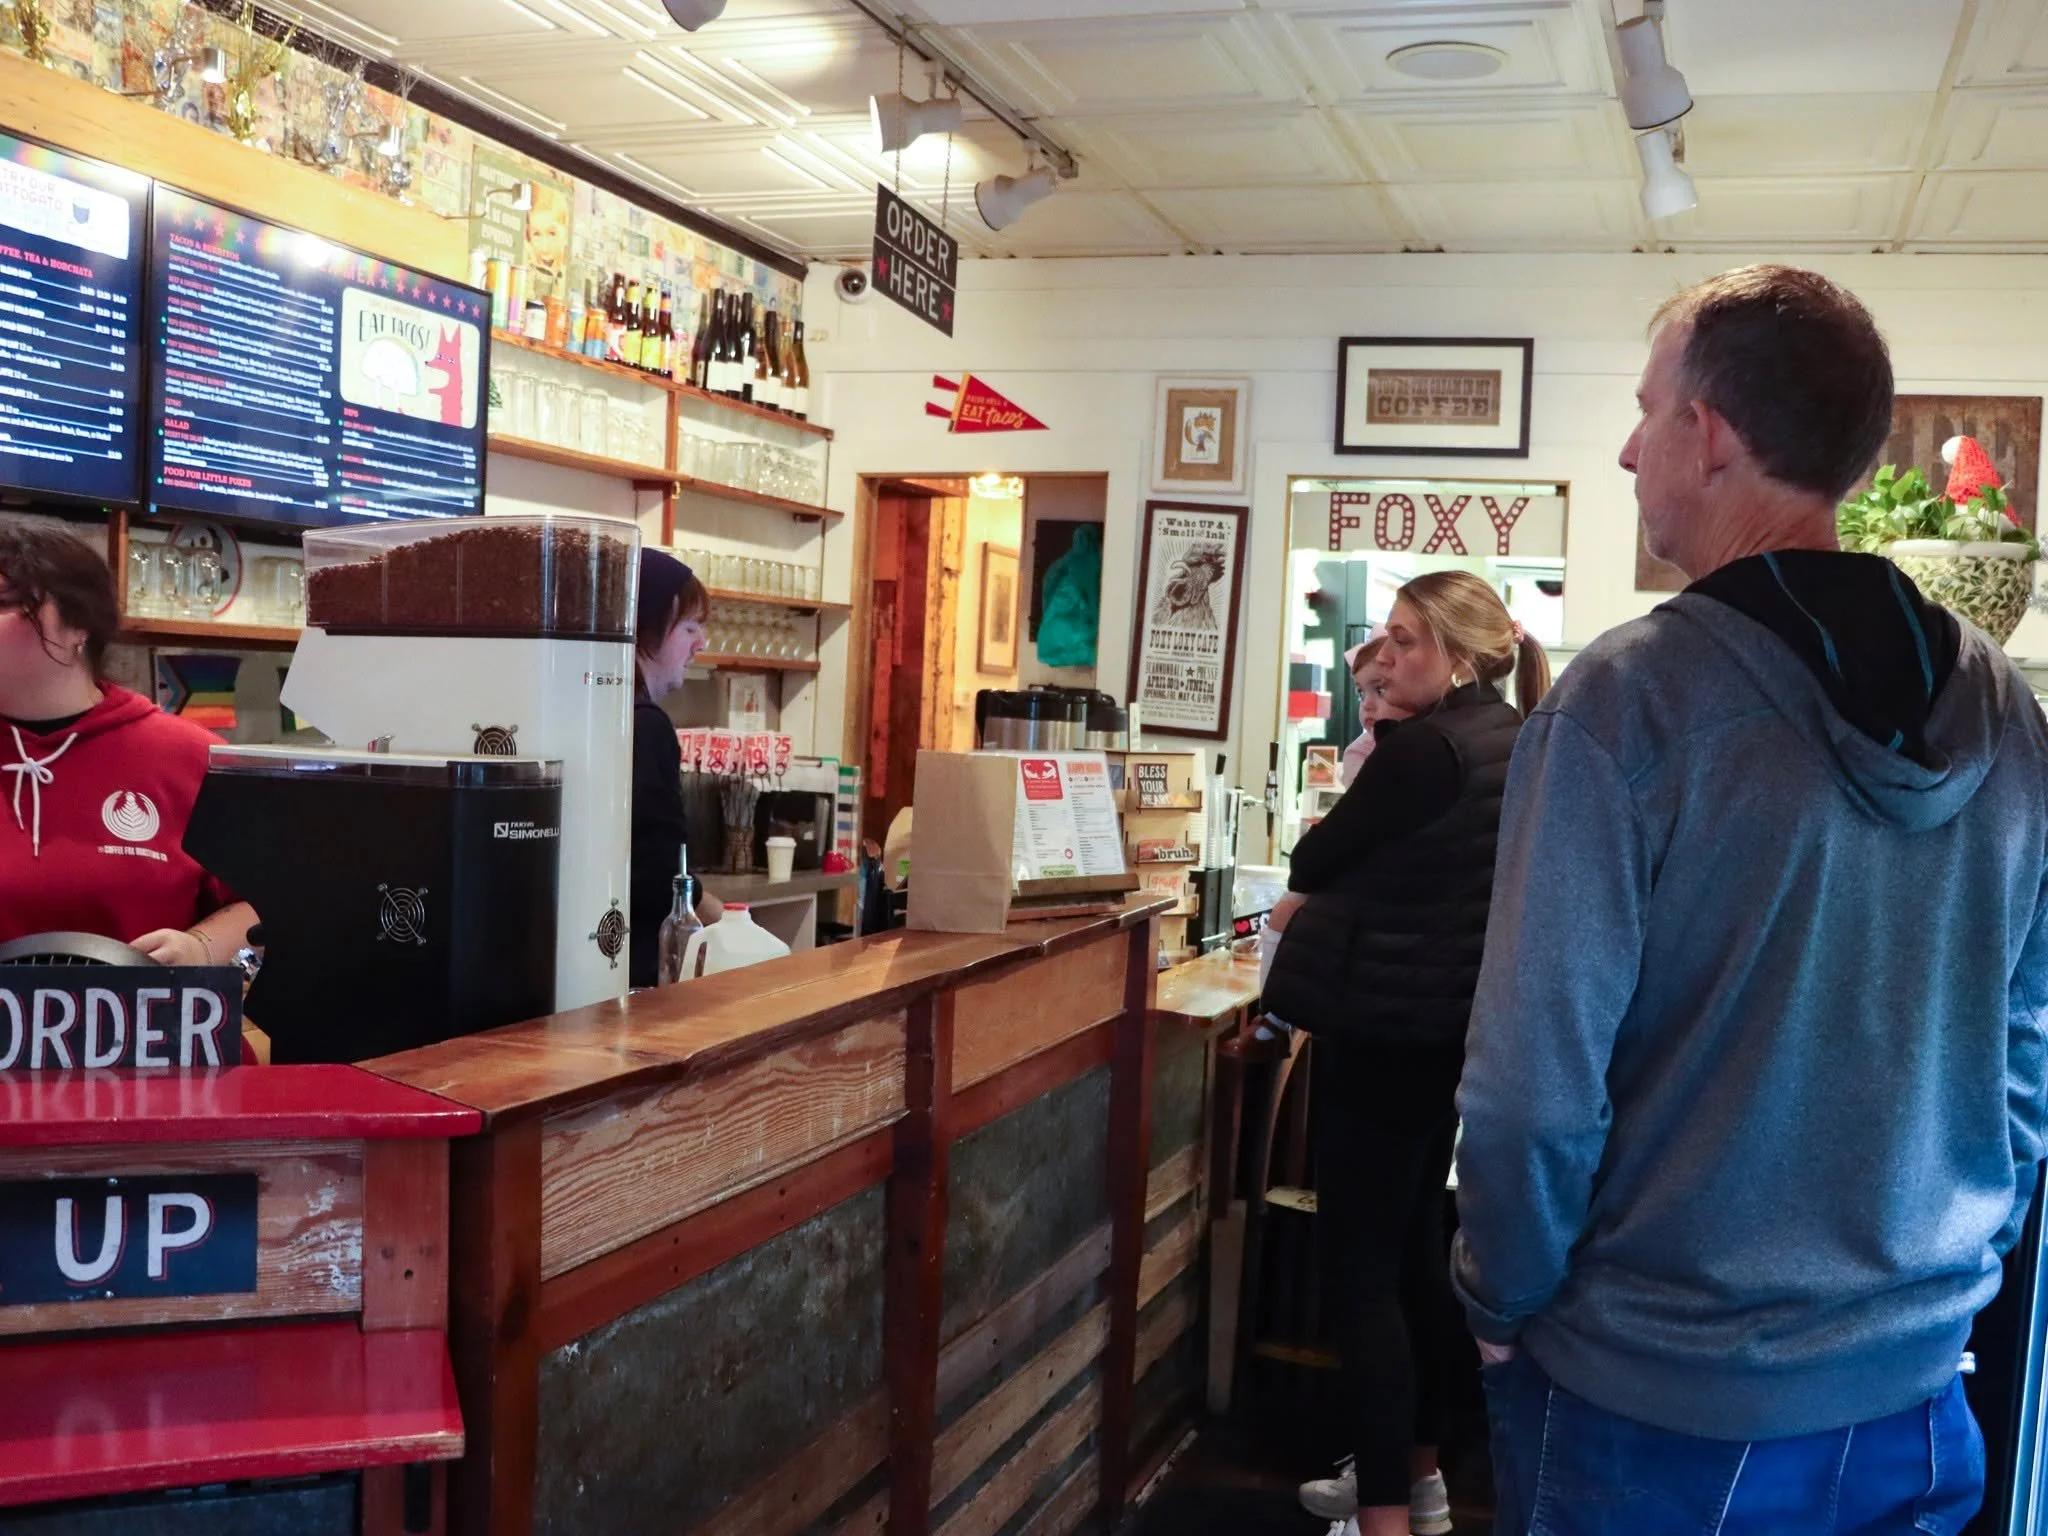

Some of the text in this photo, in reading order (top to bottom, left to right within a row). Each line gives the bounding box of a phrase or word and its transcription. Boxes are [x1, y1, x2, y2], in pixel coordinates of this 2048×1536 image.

[887, 200, 949, 277] ORDER
[24, 252, 41, 264] TEA
[41, 257, 49, 266] &
[50, 259, 93, 278] HORCHATA
[890, 254, 940, 321] HERE
[359, 310, 384, 342] EAT
[392, 316, 431, 351] TACOS!
[962, 403, 1026, 429] EAT tacos
[1378, 396, 1489, 416] COFFEE
[165, 418, 190, 430] SALAD
[164, 466, 185, 478] FOOD
[186, 469, 201, 480] FOR
[202, 471, 228, 484] LITTLE
[1166, 517, 1224, 529] Wake UP &
[1329, 491, 1530, 556] FOXY
[1162, 528, 1195, 537] Smell
[1206, 530, 1225, 539] Ink
[1150, 630, 1219, 653] FOXY LOXY CAFE
[1147, 676, 1166, 688] APRIL
[1178, 691, 1190, 701] MAY
[1139, 766, 1166, 778] BLESS
[1140, 780, 1165, 793] YOUR
[1159, 847, 1194, 860] bruh.
[0, 988, 225, 1069] ORDER
[55, 1193, 213, 1285] UP
